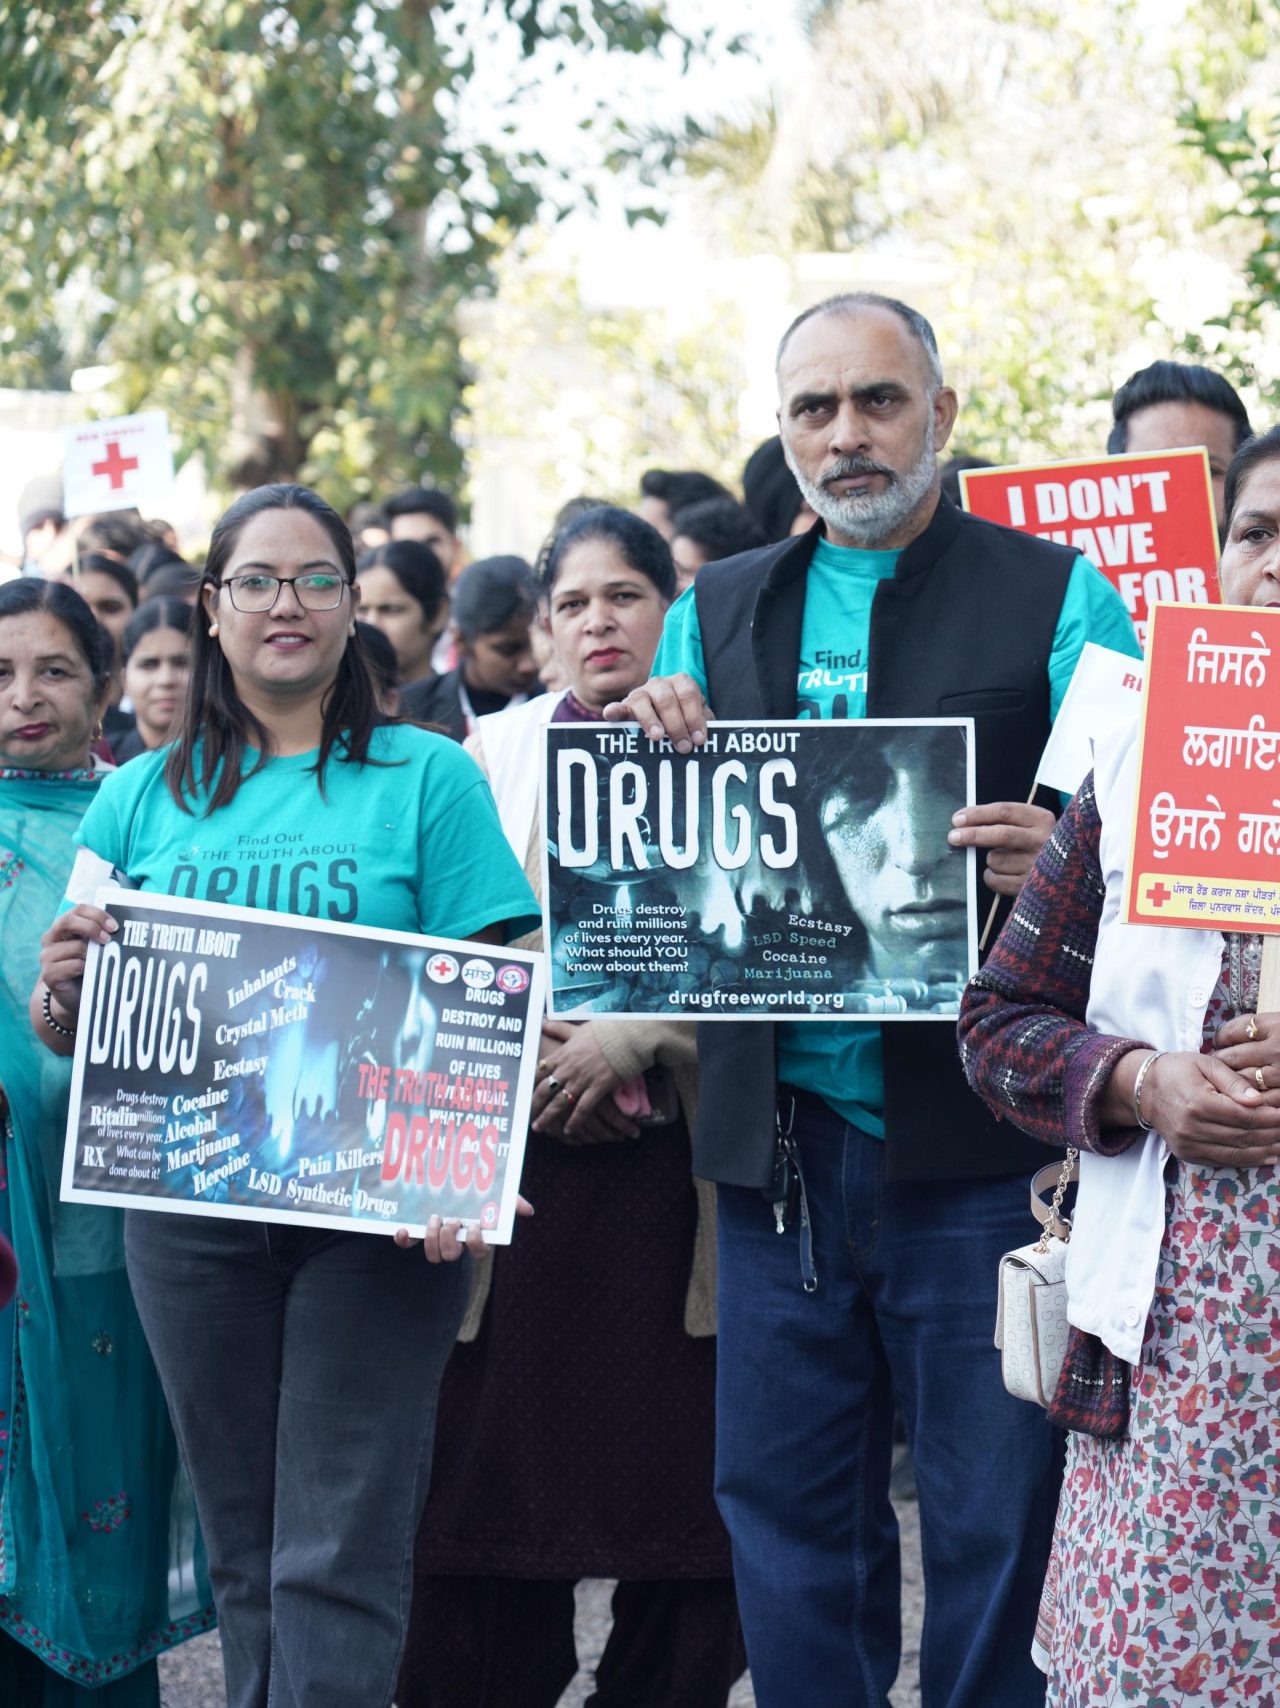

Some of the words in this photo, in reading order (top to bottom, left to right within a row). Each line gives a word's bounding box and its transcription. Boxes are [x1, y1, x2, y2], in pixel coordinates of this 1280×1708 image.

[1007, 486, 1026, 527] I
[1034, 471, 1171, 524] DON'T
[1118, 567, 1208, 614] FOR
[815, 648, 862, 669] Find
[1187, 627, 1271, 688] ਜਿਸਨੇ
[596, 733, 639, 753] THE
[648, 733, 717, 753] TRTH
[725, 732, 800, 753] ABOUT
[557, 748, 798, 871] DRUGS
[1150, 791, 1226, 859] ਉਸਨੇ
[238, 834, 270, 846] Find
[275, 833, 304, 845] Out
[202, 850, 232, 861] THE
[238, 846, 293, 861] TRUTH
[299, 843, 359, 856] ABOUT
[592, 903, 633, 917] Drugs
[636, 903, 687, 917] destroy
[578, 918, 604, 929] and
[607, 918, 633, 929] ruin
[636, 918, 687, 929] millions
[788, 914, 853, 937] Ecstasy
[122, 920, 149, 948] THE
[151, 922, 195, 953] TRUTH
[195, 928, 241, 958] ABOUT
[564, 932, 579, 943] of
[581, 932, 611, 943] lives
[614, 934, 651, 946] every
[654, 934, 688, 946] year.
[753, 932, 782, 947] LSD
[790, 932, 837, 949] Speed
[567, 946, 605, 958] What
[608, 946, 651, 958] should
[654, 947, 688, 958] YOU
[762, 950, 827, 965] Cocaine
[566, 960, 603, 972] know
[606, 960, 645, 972] about
[648, 960, 688, 972] them?
[744, 968, 833, 982] Marijuana
[227, 956, 297, 1009] Inhalants
[273, 978, 316, 1003] Crack
[90, 941, 208, 1075] DRUGS
[465, 987, 506, 1006] DRUGS
[668, 990, 845, 1009] drugfreeworld.org
[215, 1011, 267, 1046] Crystal
[270, 1001, 308, 1029] Meth
[442, 1008, 496, 1028] DESTROY
[497, 1016, 523, 1032] AND
[435, 1032, 465, 1050] RUIN
[466, 1036, 522, 1057] MILLIONS
[213, 1055, 269, 1081] Ecstasy
[449, 1059, 466, 1075] OF
[467, 1062, 502, 1080] LIVES
[116, 1088, 139, 1106] Drugs
[140, 1089, 168, 1109] destroy
[358, 1064, 391, 1100] THE
[394, 1069, 449, 1108] TRUTH
[449, 1076, 509, 1114] ABOUT
[172, 1086, 229, 1116] Cocaine
[90, 1105, 138, 1127] Ritalin
[137, 1109, 166, 1125] millions
[164, 1111, 217, 1144] Alcohal
[98, 1125, 107, 1137] of
[107, 1127, 123, 1139] lives
[124, 1129, 144, 1143] every
[146, 1133, 163, 1144] year.
[82, 1145, 107, 1168] RX
[116, 1145, 136, 1160] What
[138, 1149, 151, 1161] can
[151, 1148, 162, 1162] be
[166, 1133, 241, 1173] Marijuana
[298, 1155, 332, 1178] Pain
[335, 1148, 384, 1172] Killers
[381, 1112, 499, 1191] DRUGS
[109, 1164, 127, 1177] done
[128, 1167, 150, 1179] about
[151, 1168, 160, 1180] it?
[193, 1152, 250, 1195] Heroine
[248, 1167, 282, 1196] LSD
[287, 1178, 352, 1205] Synthetic
[356, 1189, 398, 1219] Drugs
